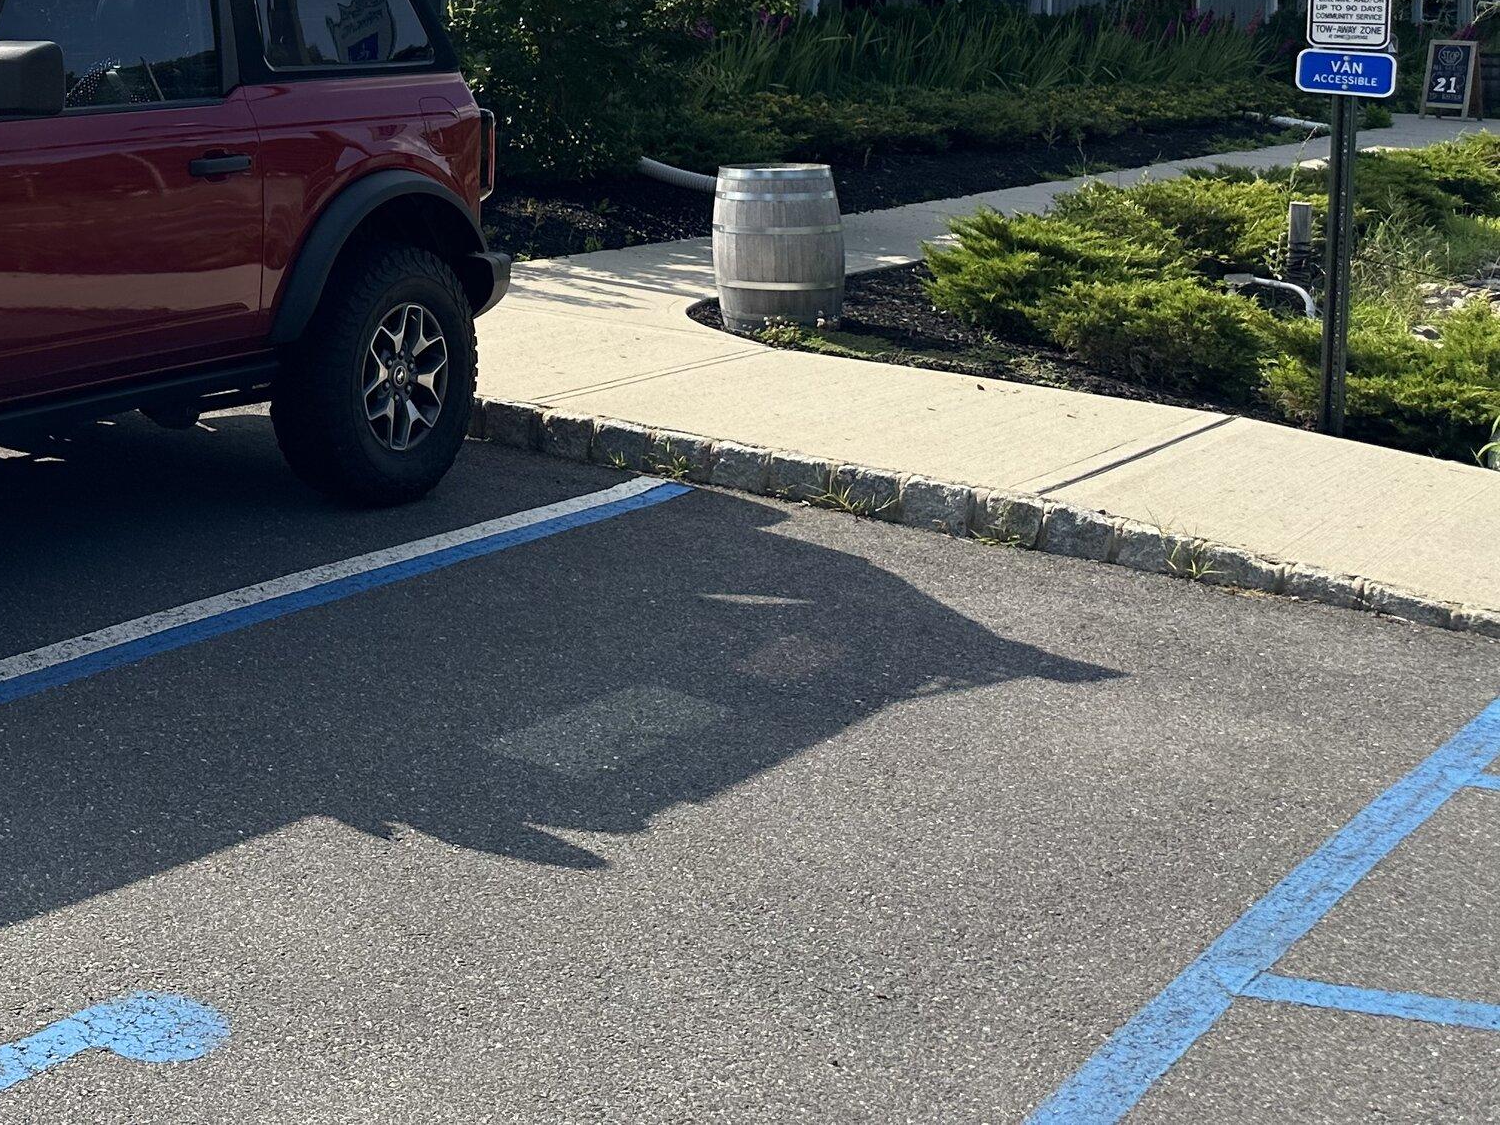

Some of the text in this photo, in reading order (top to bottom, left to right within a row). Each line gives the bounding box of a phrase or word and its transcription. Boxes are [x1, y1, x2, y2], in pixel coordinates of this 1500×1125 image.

[1315, 12, 1382, 21] COMMUNITY SERVICE
[1315, 24, 1382, 35] TOW-AWAY ZONE
[1331, 60, 1363, 75] VAN
[1313, 74, 1378, 87] ACCESSIBLE
[1433, 77, 1457, 93] 21
